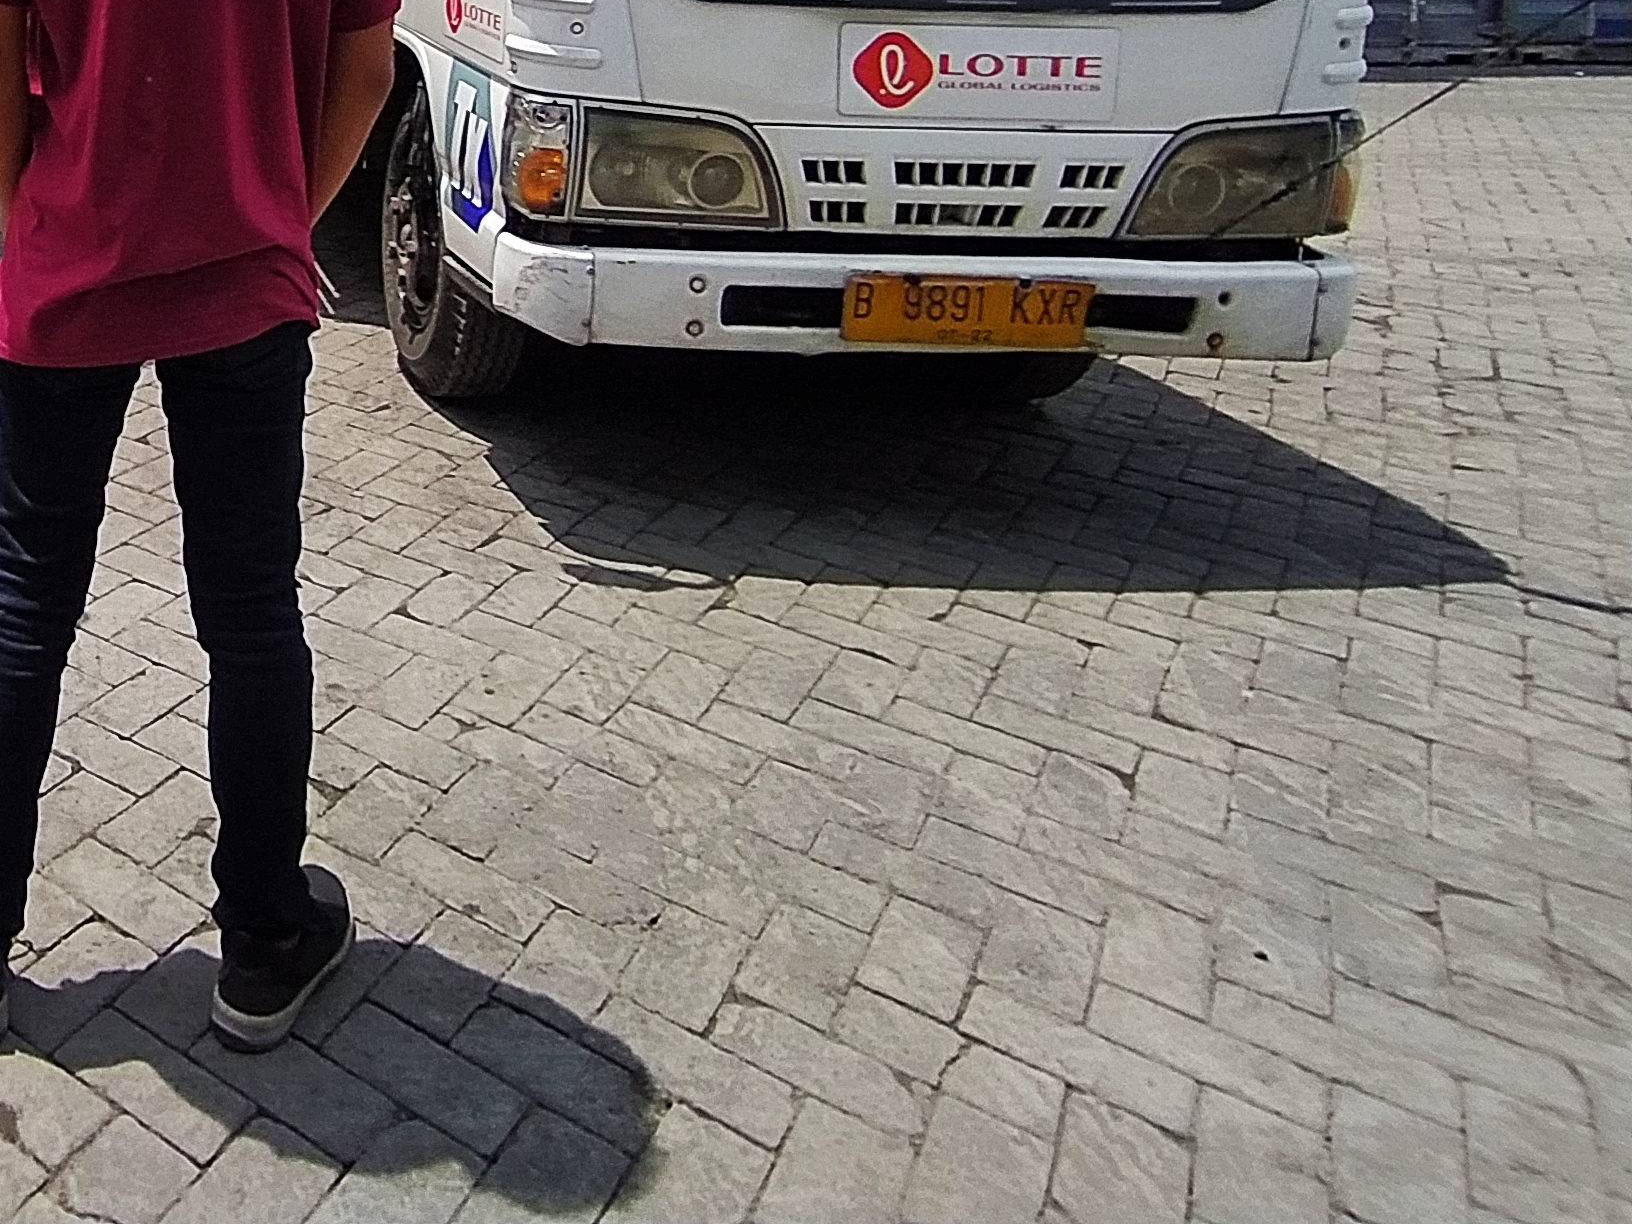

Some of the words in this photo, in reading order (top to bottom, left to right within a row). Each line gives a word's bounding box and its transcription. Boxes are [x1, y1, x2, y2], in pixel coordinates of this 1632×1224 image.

[464, 2, 502, 32] LOTTE
[938, 53, 1103, 79] LOTTE
[937, 80, 1003, 91] GLOBAL
[1011, 80, 1102, 92] LOGISTICS
[853, 281, 875, 319] B
[903, 284, 986, 323] 9891
[1009, 284, 1082, 325] KXR
